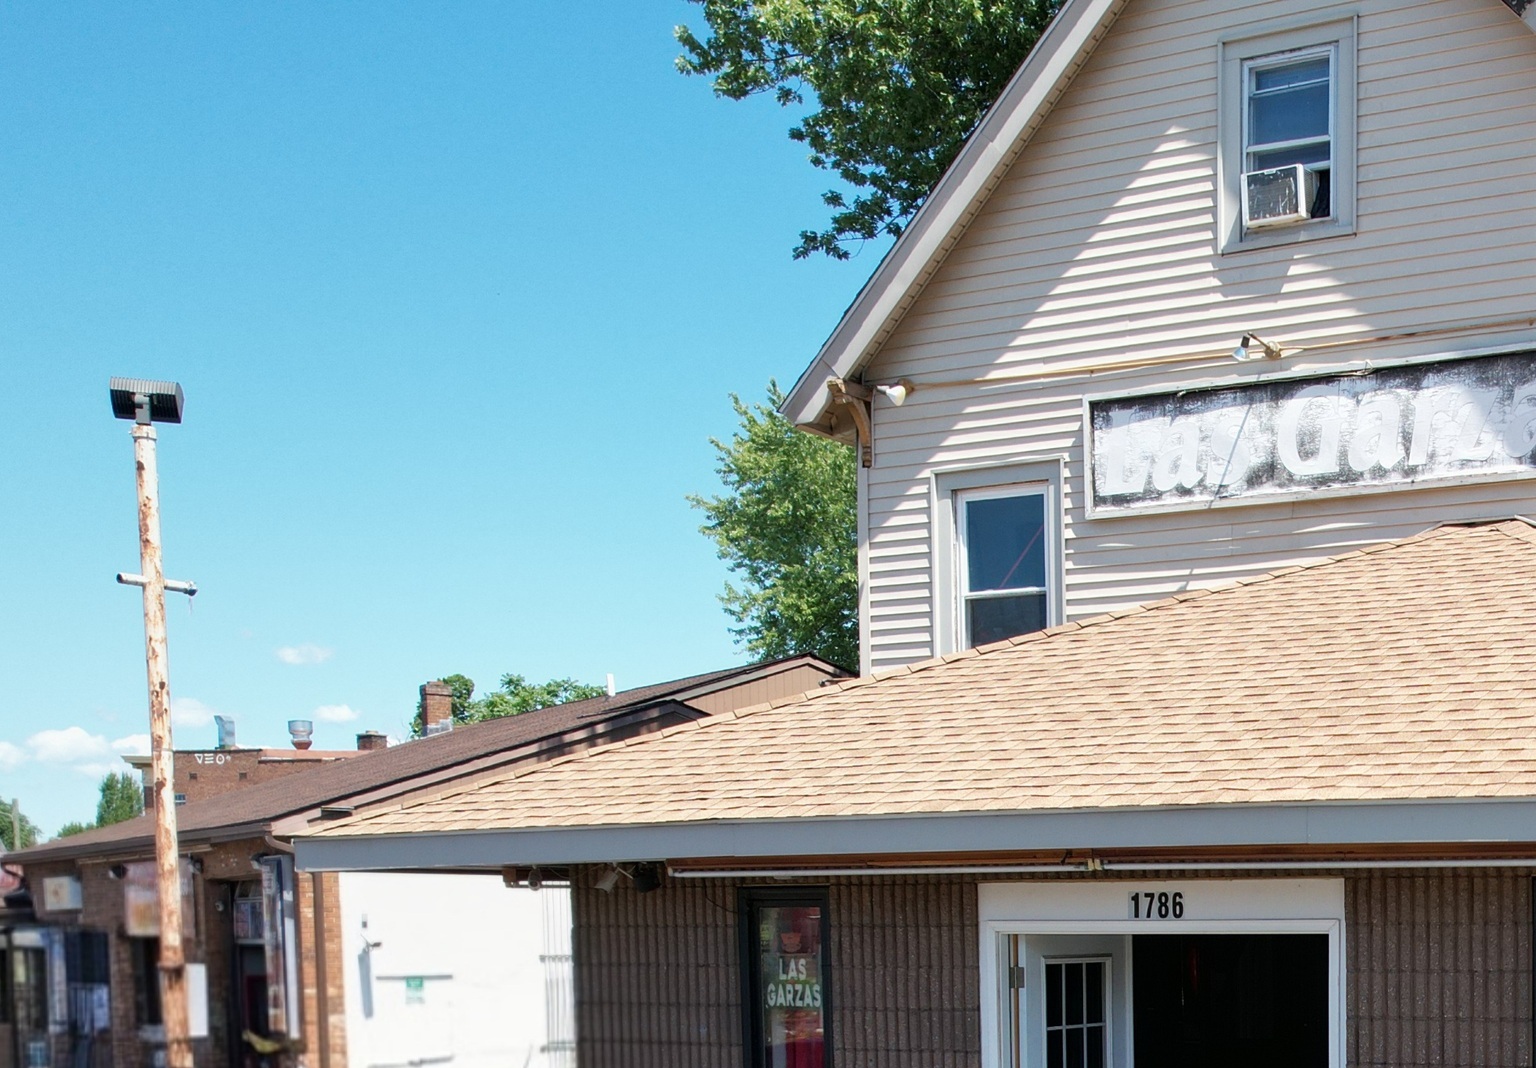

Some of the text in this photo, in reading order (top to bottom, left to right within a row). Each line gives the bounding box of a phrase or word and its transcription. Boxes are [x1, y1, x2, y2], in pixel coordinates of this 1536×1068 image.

[1099, 408, 1251, 496] Las
[1131, 892, 1184, 919] 1786
[779, 958, 807, 981] LAS
[767, 983, 821, 1007] GARZAS
